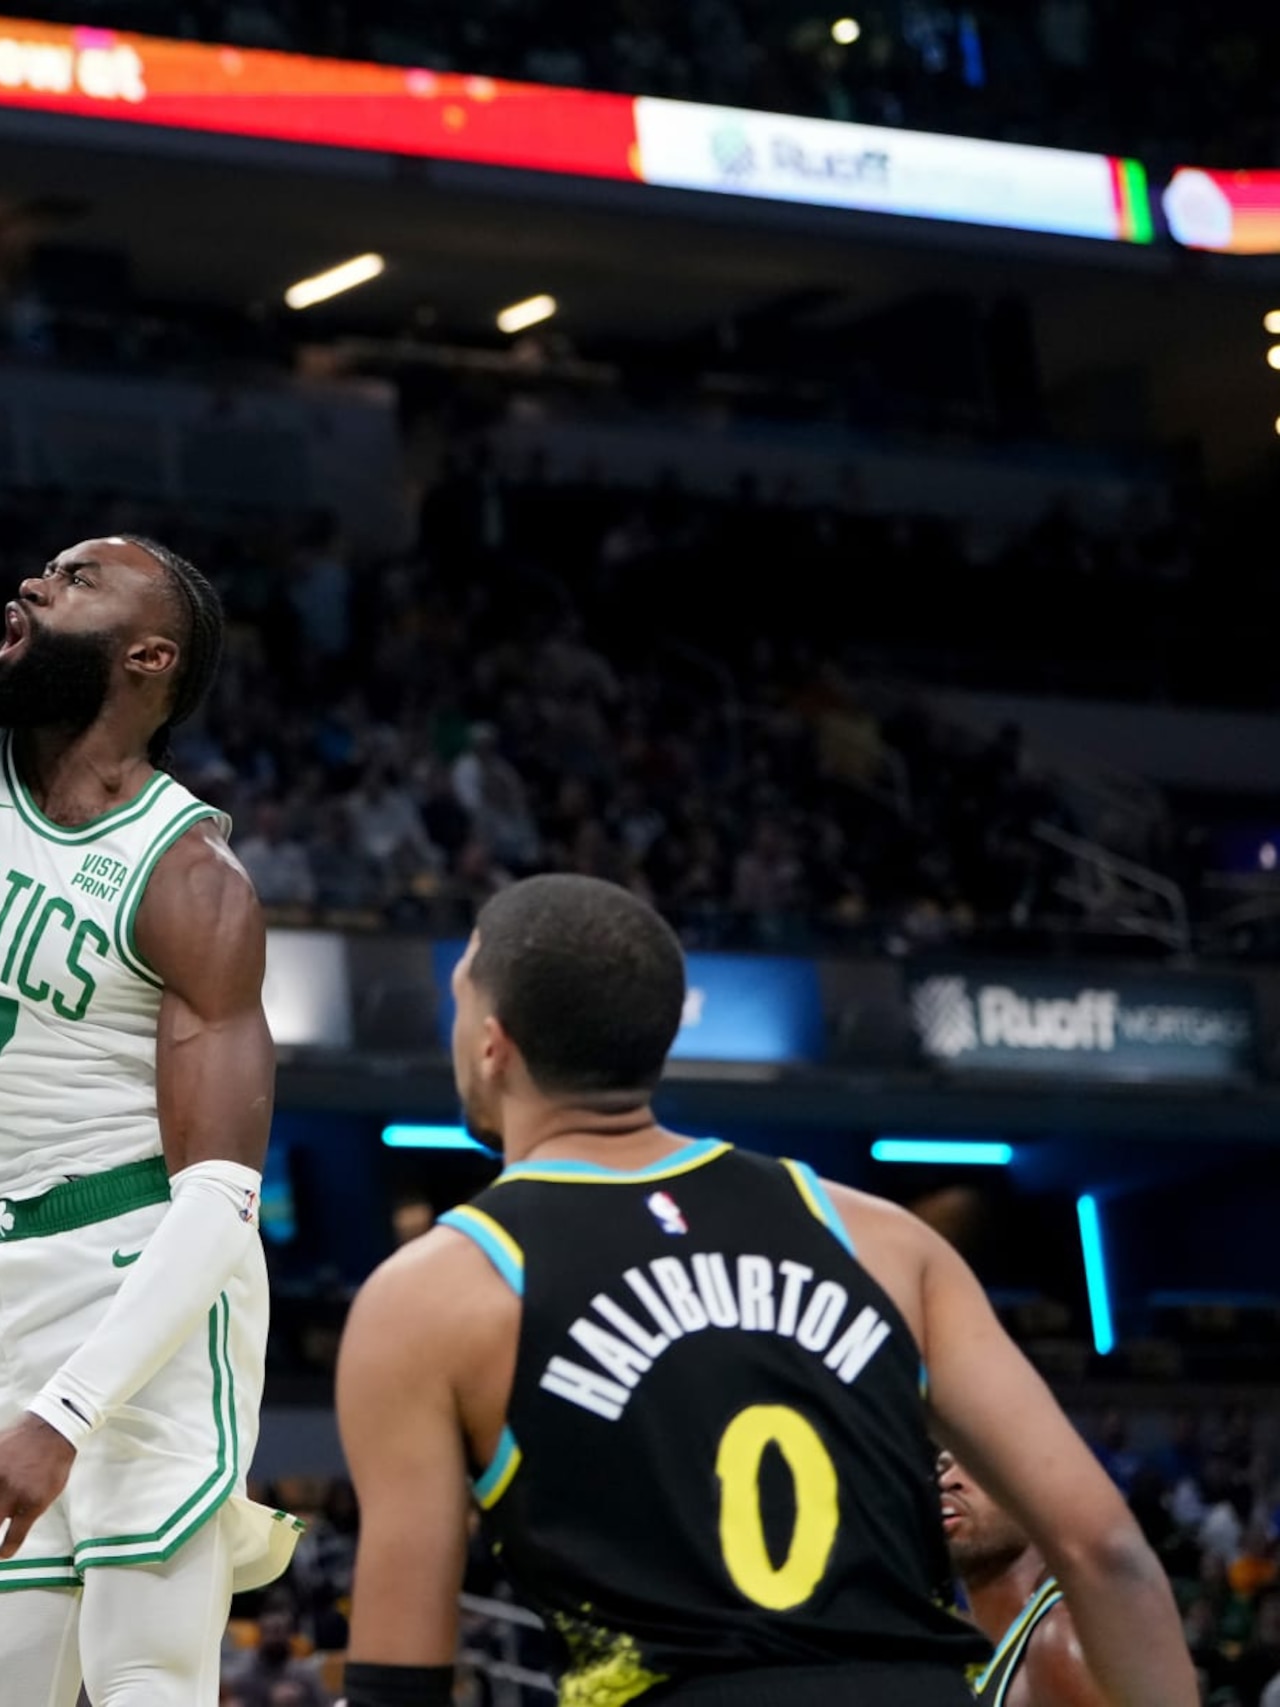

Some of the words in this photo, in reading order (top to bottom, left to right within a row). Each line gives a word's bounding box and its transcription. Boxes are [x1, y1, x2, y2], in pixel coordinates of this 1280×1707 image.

[71, 872, 119, 902] PRINT
[80, 853, 128, 887] VISTA
[978, 985, 1118, 1052] Ruoff
[539, 1252, 891, 1421] HALIBURTON
[715, 1404, 839, 1611] 0
